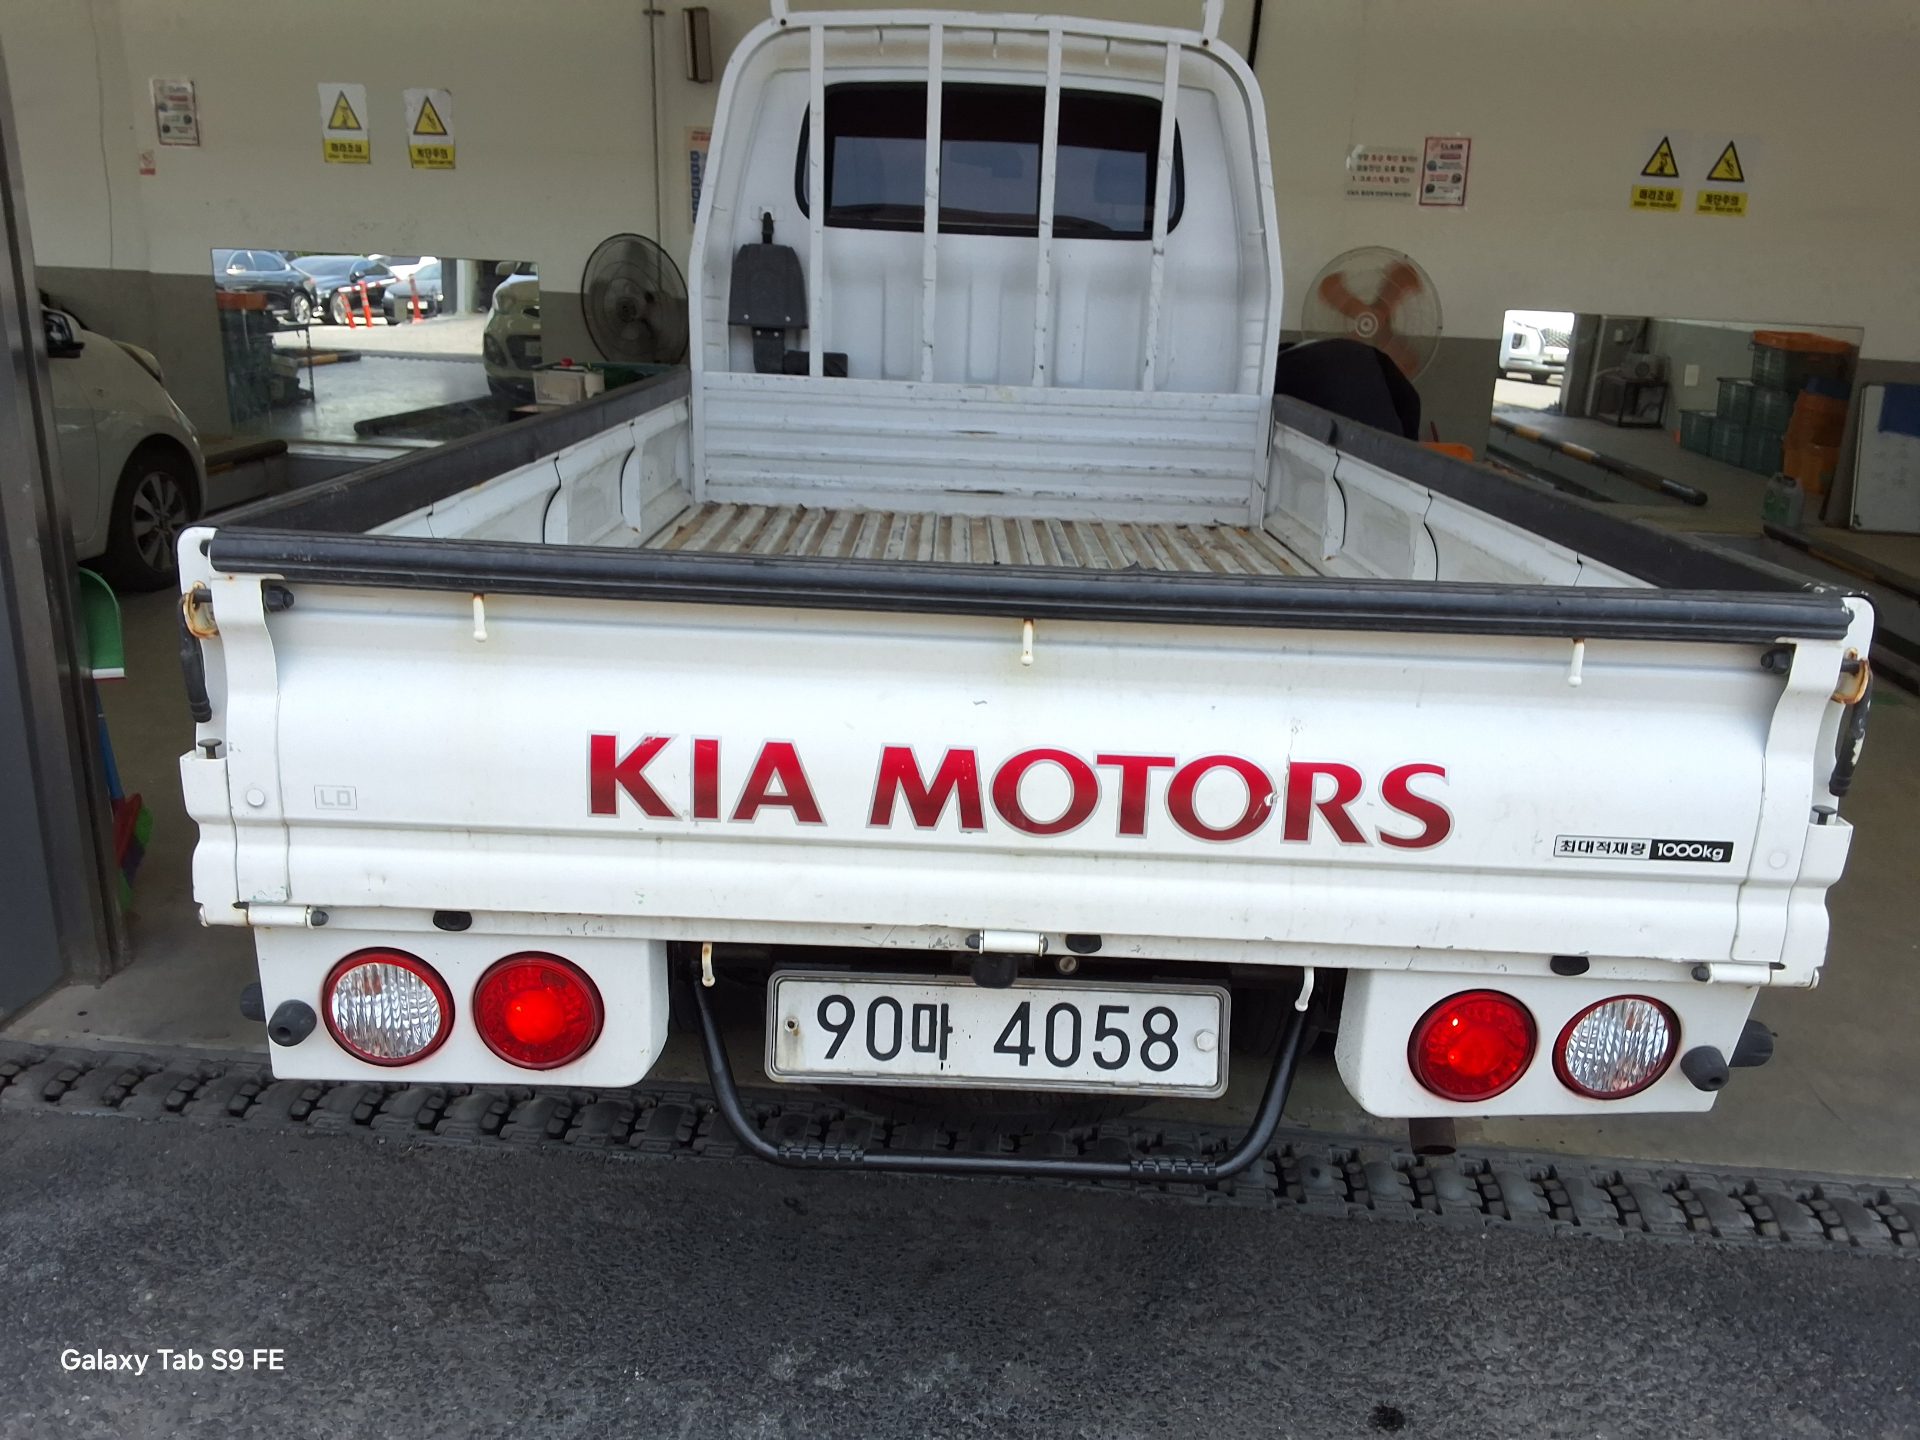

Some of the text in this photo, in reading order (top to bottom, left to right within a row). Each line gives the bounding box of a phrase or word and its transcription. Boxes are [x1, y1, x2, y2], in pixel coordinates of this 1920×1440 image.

[587, 731, 1455, 851] KIA MOTORS
[1559, 839, 1725, 862] 최대적재량 1000kg
[816, 994, 1180, 1072] 90마 4058
